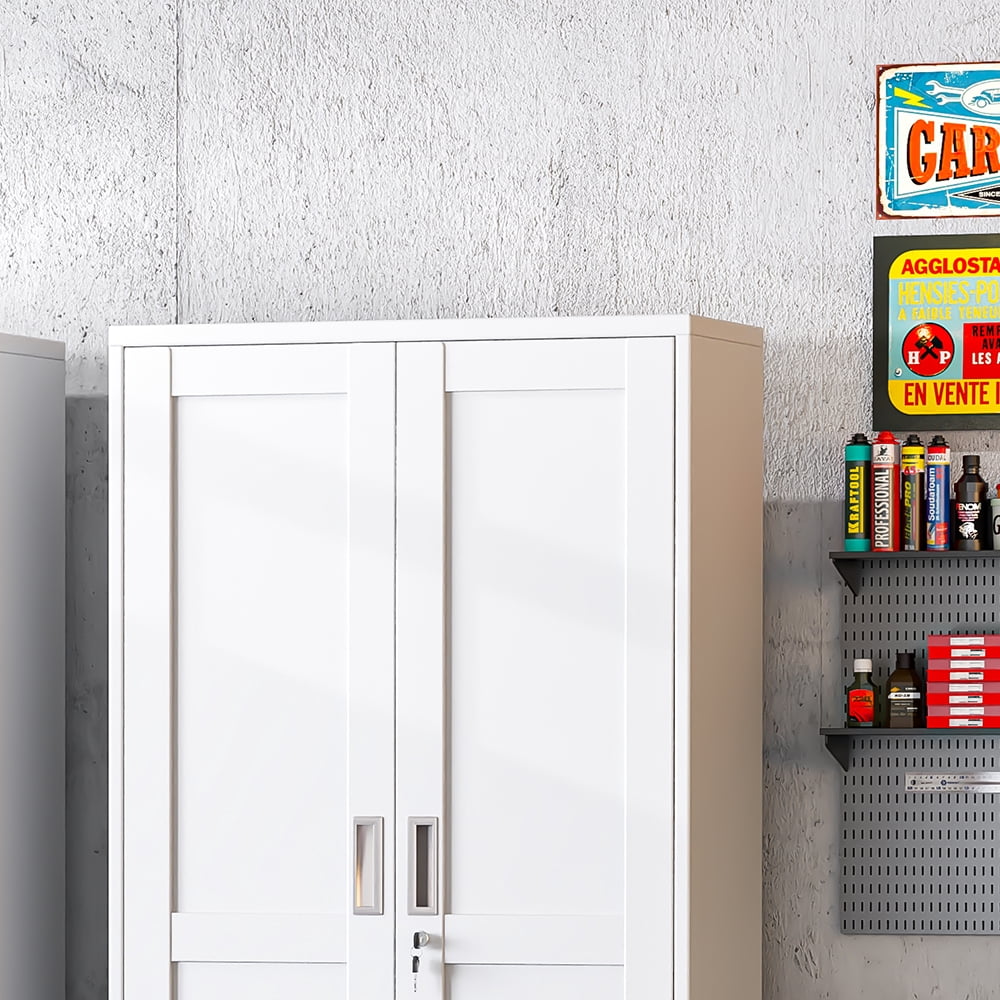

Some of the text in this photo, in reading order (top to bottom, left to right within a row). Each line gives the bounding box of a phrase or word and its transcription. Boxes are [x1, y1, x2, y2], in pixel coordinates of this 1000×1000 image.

[907, 119, 1000, 185] GAR
[901, 257, 1000, 275] AGGLOSTA
[898, 280, 1000, 305] HENSIES-PO
[898, 308, 907, 320] A
[911, 307, 952, 320] FAIBLE
[908, 350, 951, 364] H P
[972, 352, 992, 364] LES
[904, 382, 926, 406] EN
[933, 381, 990, 405] VENTE
[848, 466, 859, 533] KRAFTOOL
[928, 467, 936, 521] Soudafoam
[875, 469, 889, 547] PROFESSIONAL
